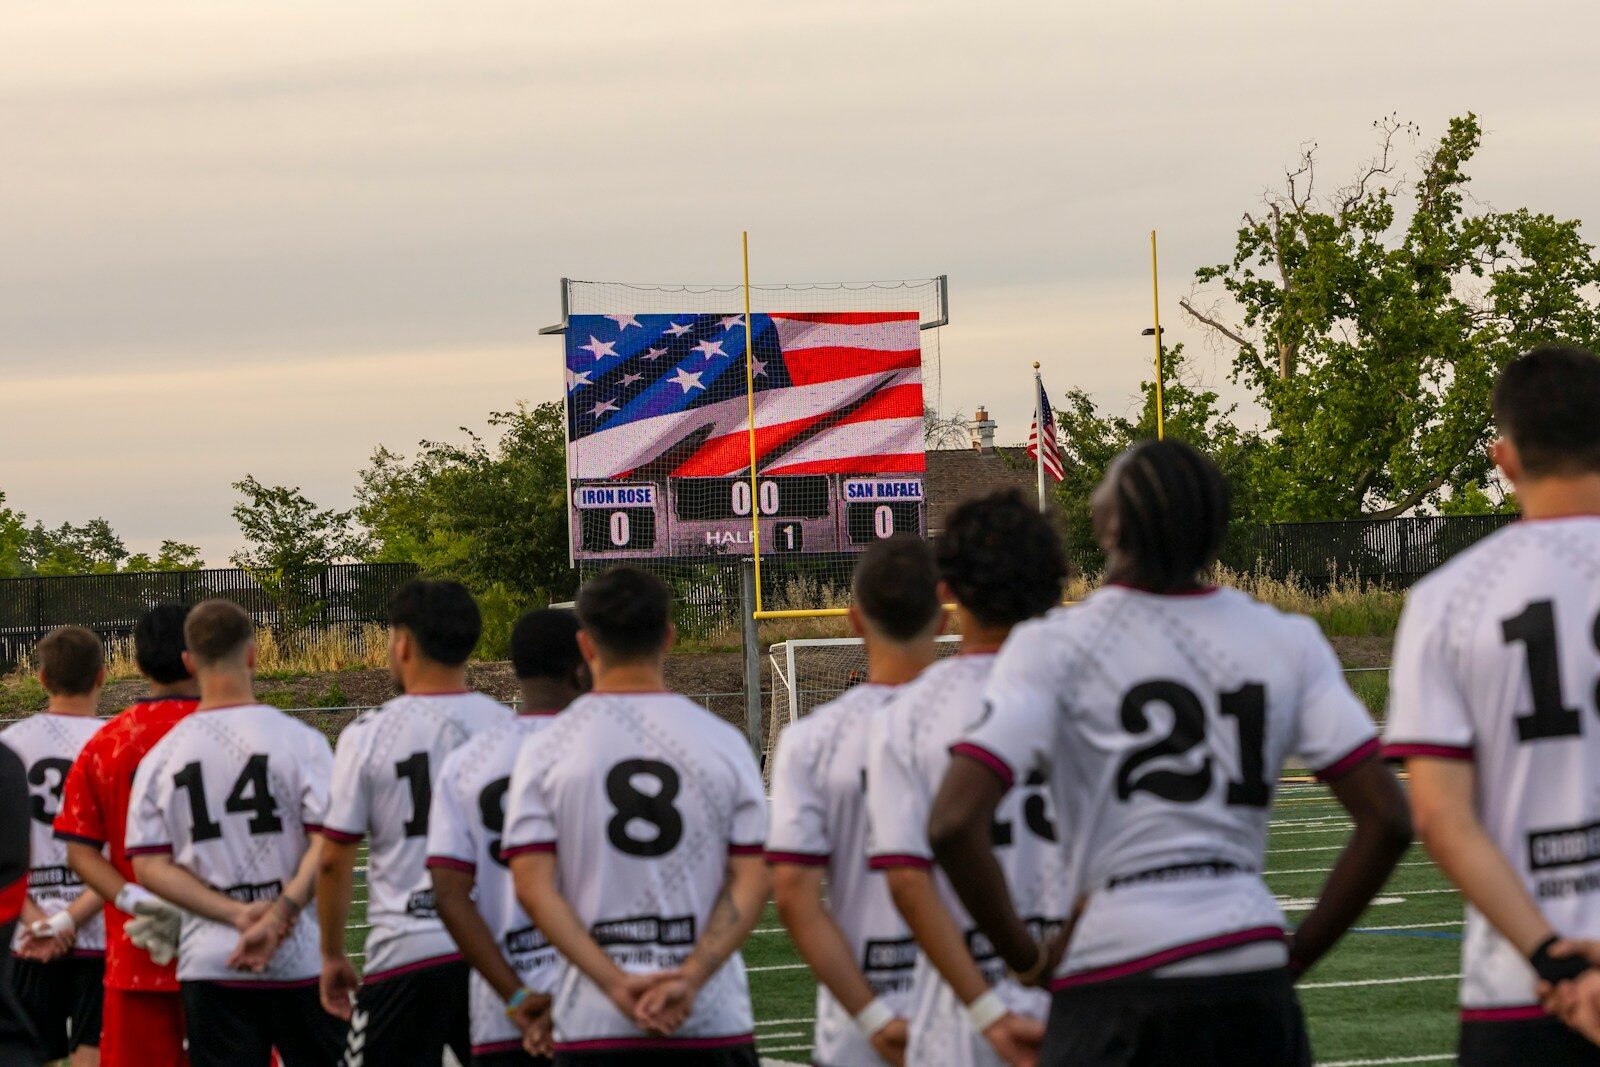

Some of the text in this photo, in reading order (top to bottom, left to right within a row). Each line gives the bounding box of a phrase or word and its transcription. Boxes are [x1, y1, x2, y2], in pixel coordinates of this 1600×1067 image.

[582, 488, 652, 504] IRON ROSE
[848, 482, 922, 498] SAN RAFAEL
[610, 511, 630, 547] 0
[706, 530, 760, 545] HALF
[783, 524, 794, 550] 1
[874, 505, 894, 539] 0
[1500, 600, 1600, 741] 1
[1116, 680, 1271, 807] 21
[173, 753, 283, 842] 14
[605, 758, 683, 859] 8
